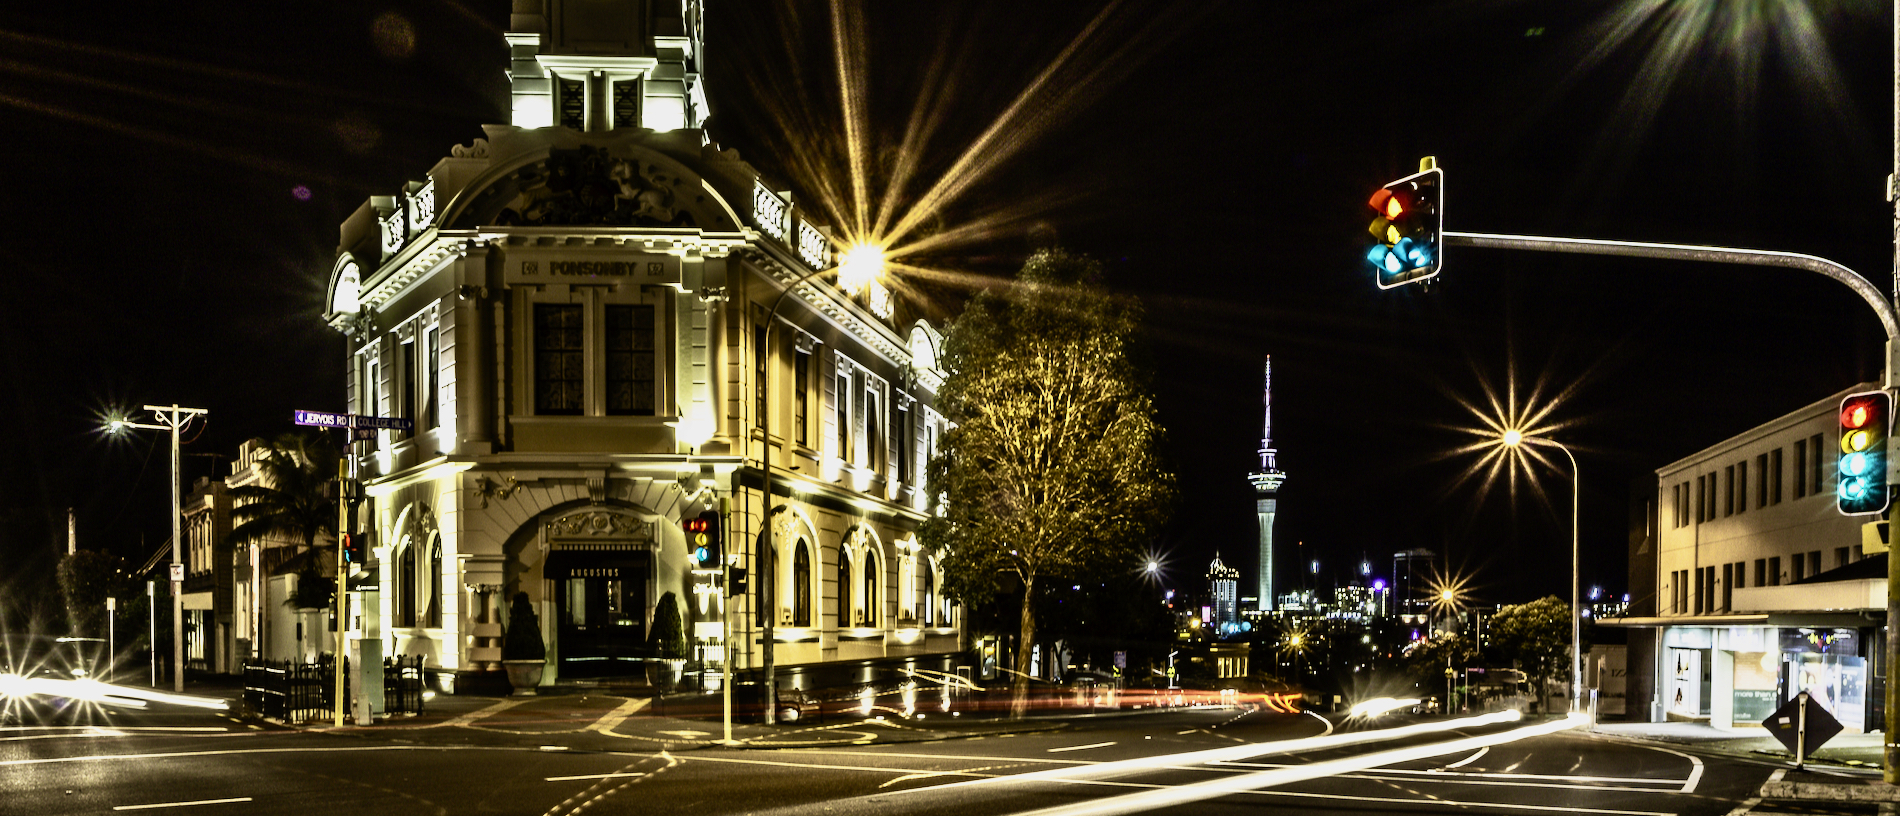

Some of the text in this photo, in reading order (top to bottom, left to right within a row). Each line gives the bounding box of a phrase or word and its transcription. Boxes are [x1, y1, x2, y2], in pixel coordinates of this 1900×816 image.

[549, 261, 637, 276] PONSONBY
[305, 412, 347, 426] JERVOIS RD
[357, 417, 407, 429] COLLEGE HILL
[570, 568, 619, 577] AUGUSTUS
